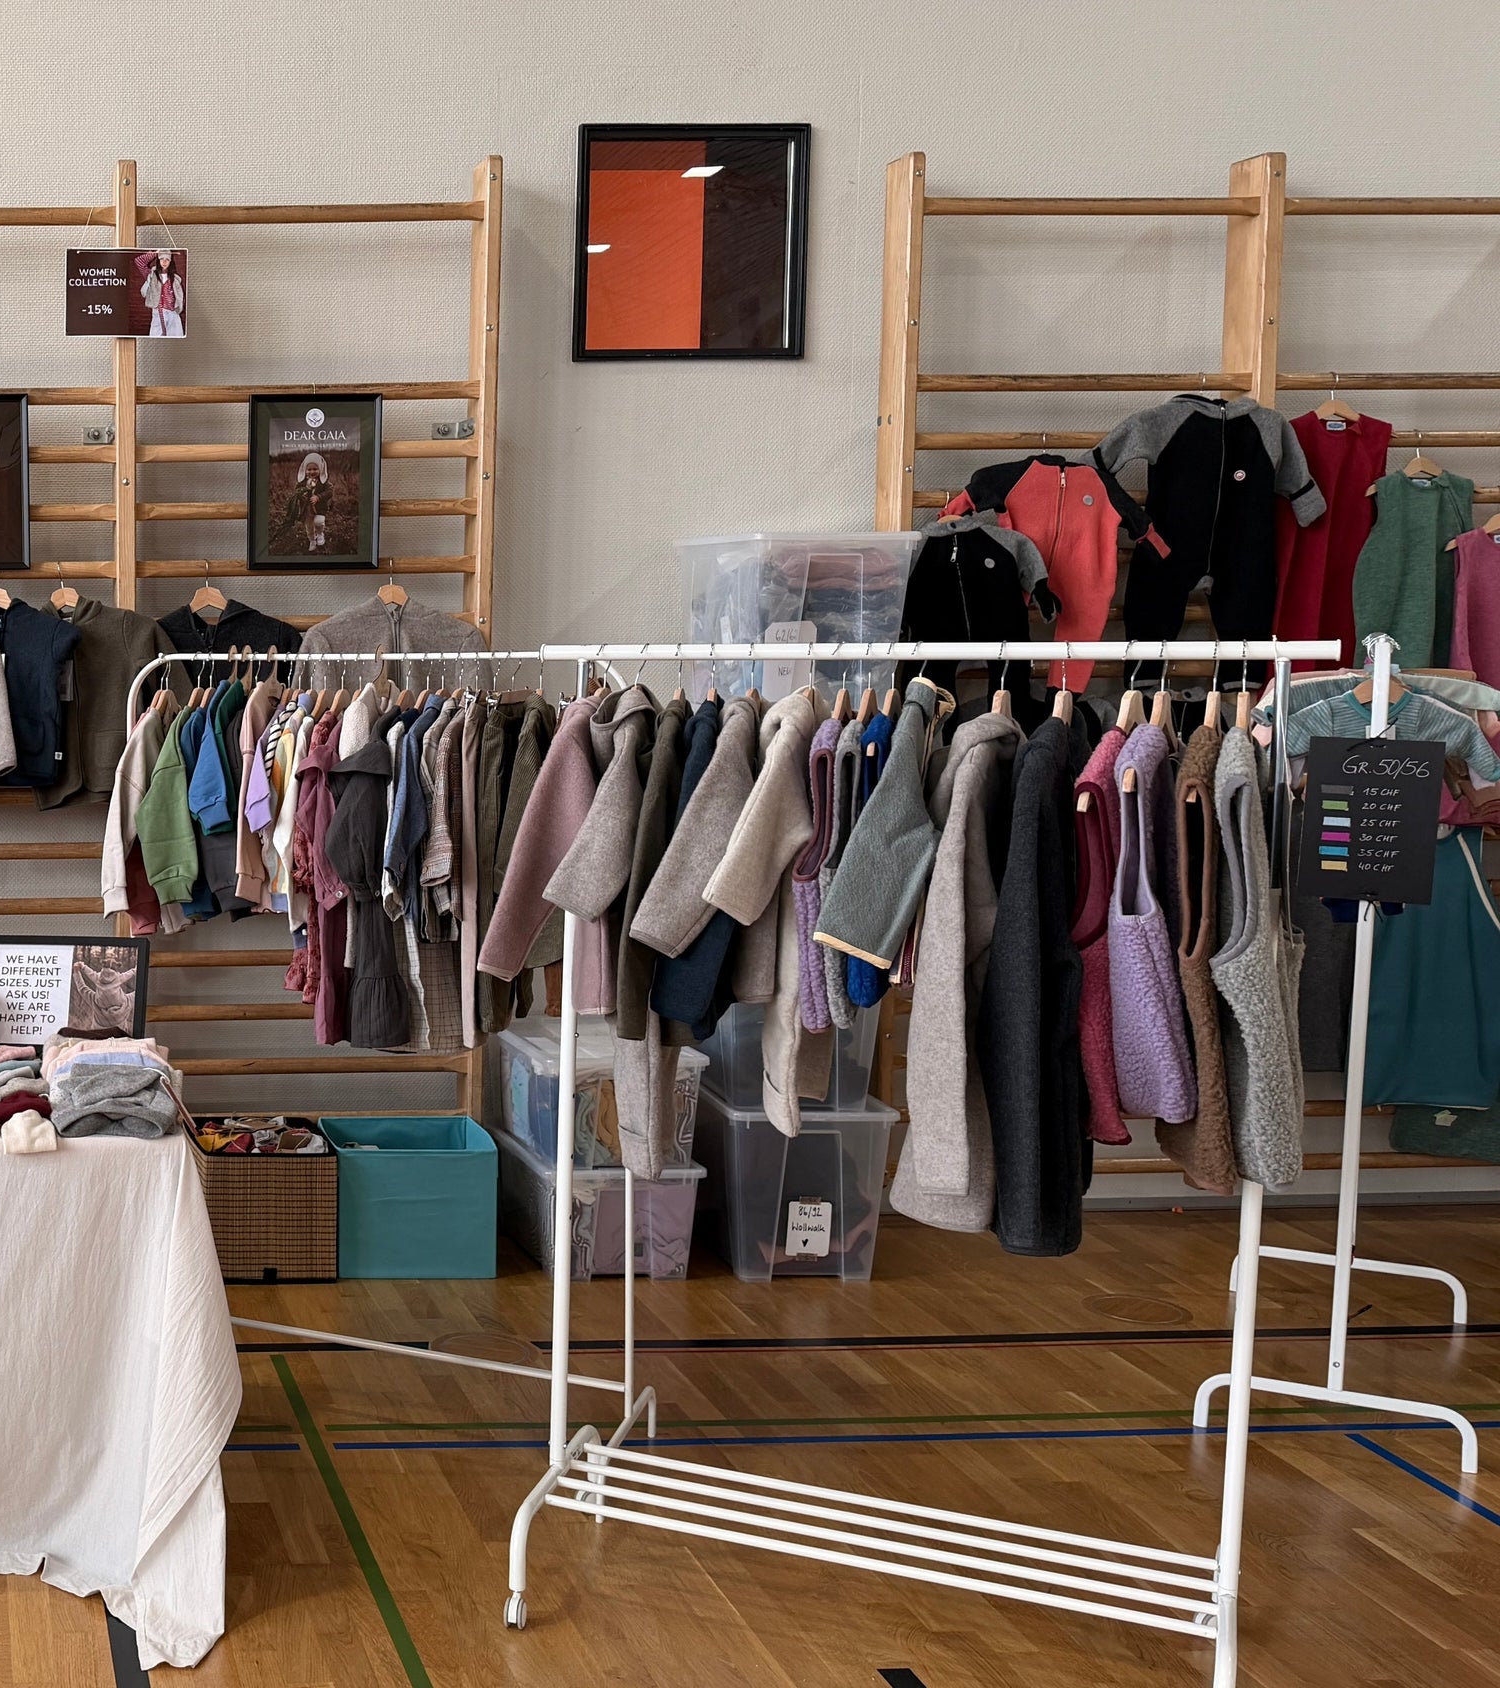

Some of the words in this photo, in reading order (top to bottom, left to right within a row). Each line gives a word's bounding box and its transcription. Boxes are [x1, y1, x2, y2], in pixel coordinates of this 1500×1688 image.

[79, 268, 117, 276] WOMEN
[69, 278, 127, 287] COLLECTION
[82, 305, 113, 315] -15%
[284, 431, 315, 441] DEAR
[318, 431, 346, 441] GAIA
[1380, 789, 1401, 797] CHF
[1380, 804, 1402, 812] CHF
[1360, 819, 1376, 827] 25
[1375, 850, 1400, 858] CHF
[1358, 863, 1371, 871] 40
[6, 955, 24, 964] WE
[27, 955, 58, 965] HAVE
[1, 967, 61, 977] DIFFERENT
[0, 978, 32, 987] SIZES.
[35, 979, 62, 988] JUST
[6, 990, 28, 999] ASK
[31, 991, 50, 1000] US!
[7, 1002, 24, 1011] WE
[28, 1002, 50, 1012] ARE
[0, 1013, 37, 1023] HAPPY
[40, 1015, 56, 1024] TO
[11, 1026, 43, 1036] HELP!
[791, 1222, 826, 1233] Wollwalk
